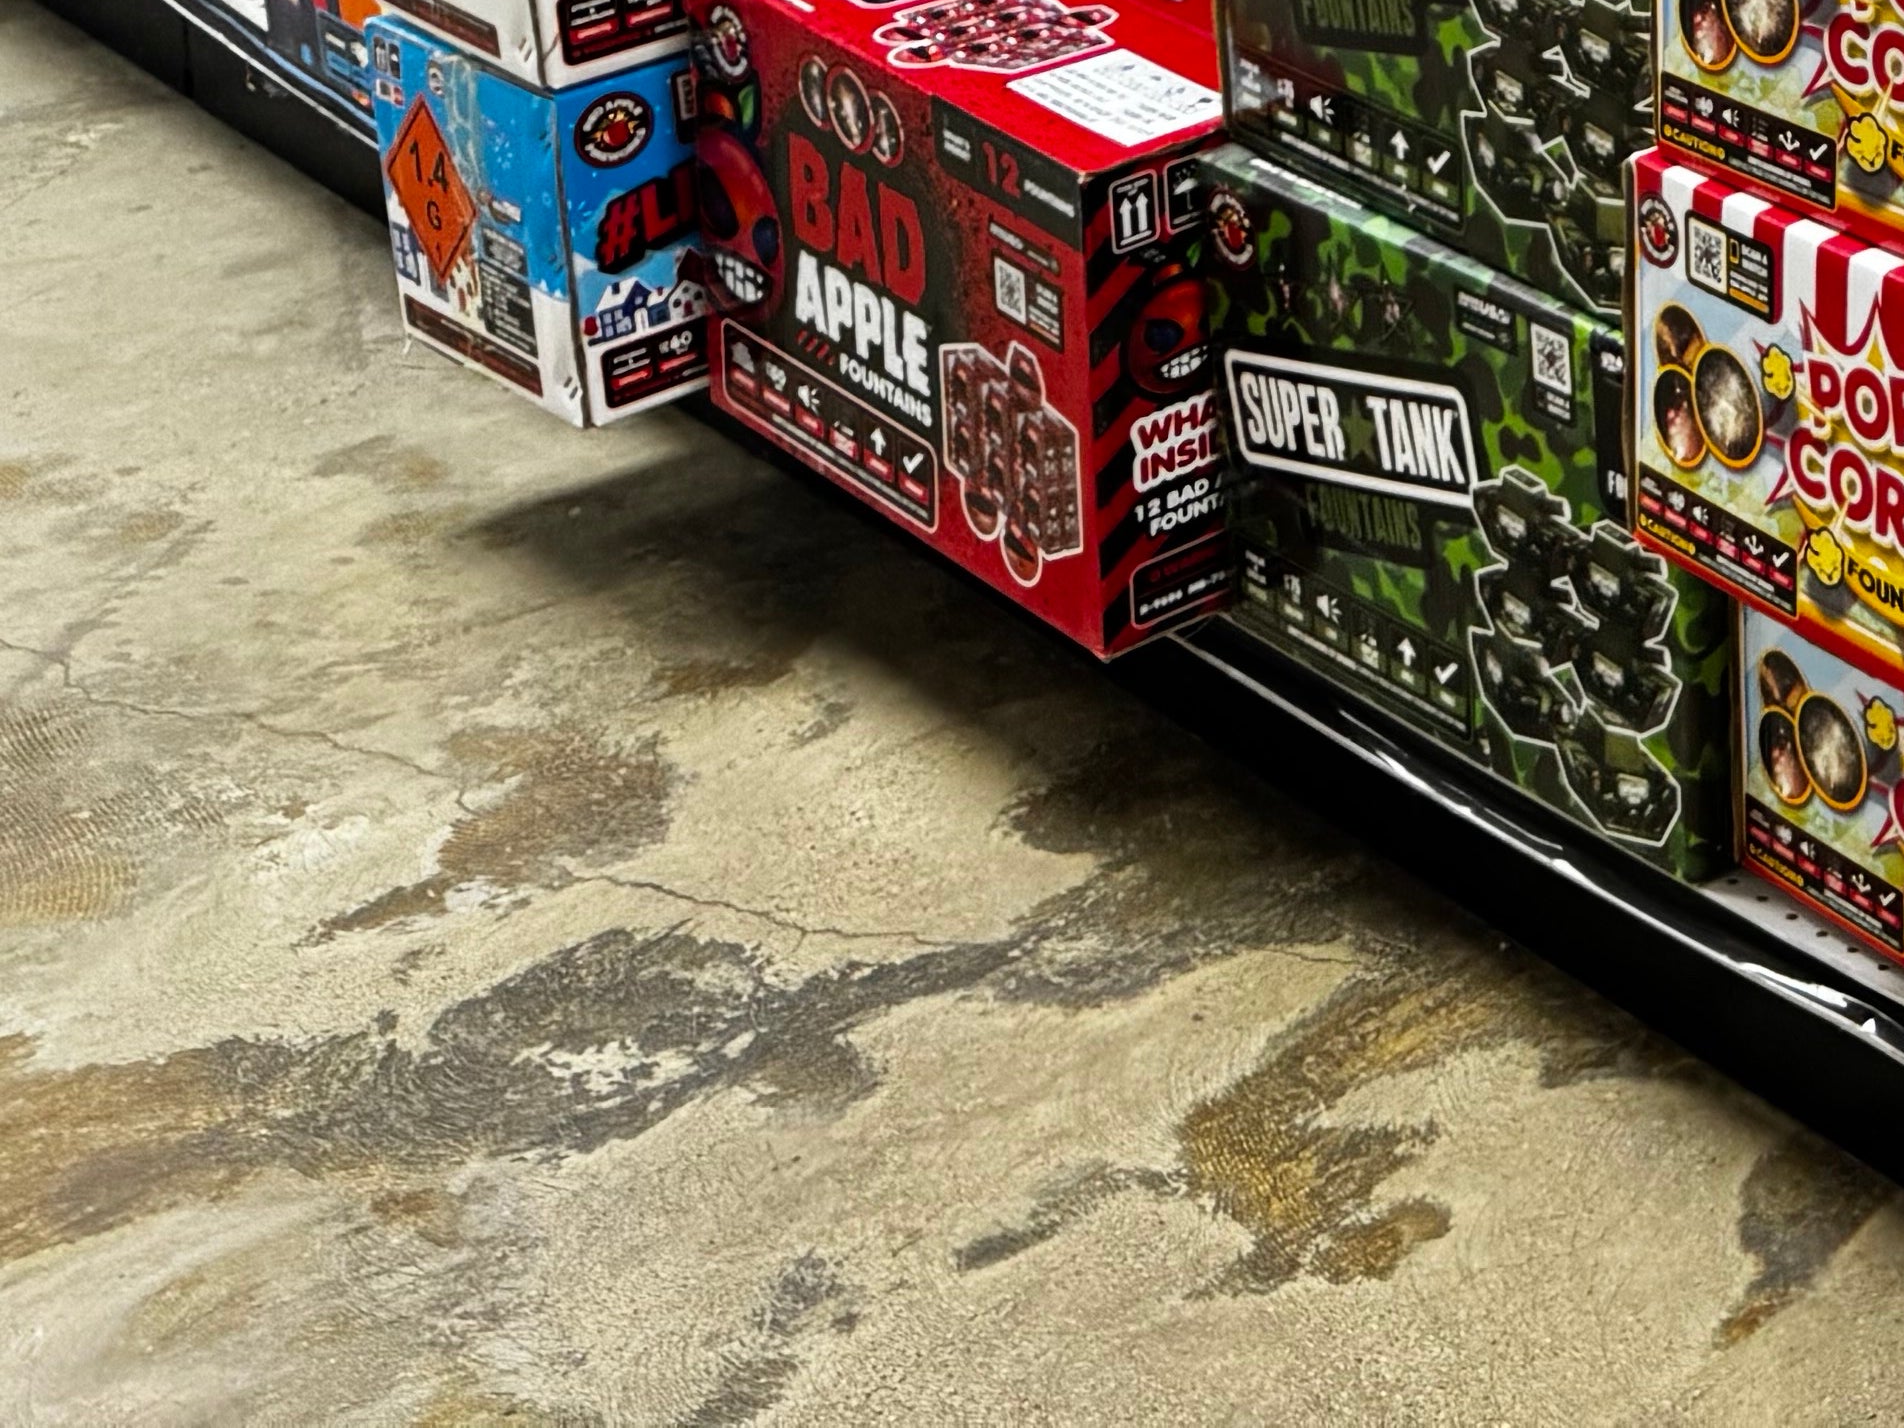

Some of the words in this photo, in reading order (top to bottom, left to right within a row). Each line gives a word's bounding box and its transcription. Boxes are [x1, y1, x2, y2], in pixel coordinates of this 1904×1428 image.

[405, 137, 449, 190] 1.4
[984, 144, 1021, 200] 12
[425, 200, 442, 229] G
[789, 135, 926, 304] BAD
[795, 254, 931, 398] APPLE
[839, 356, 933, 427] FOUNTAINS
